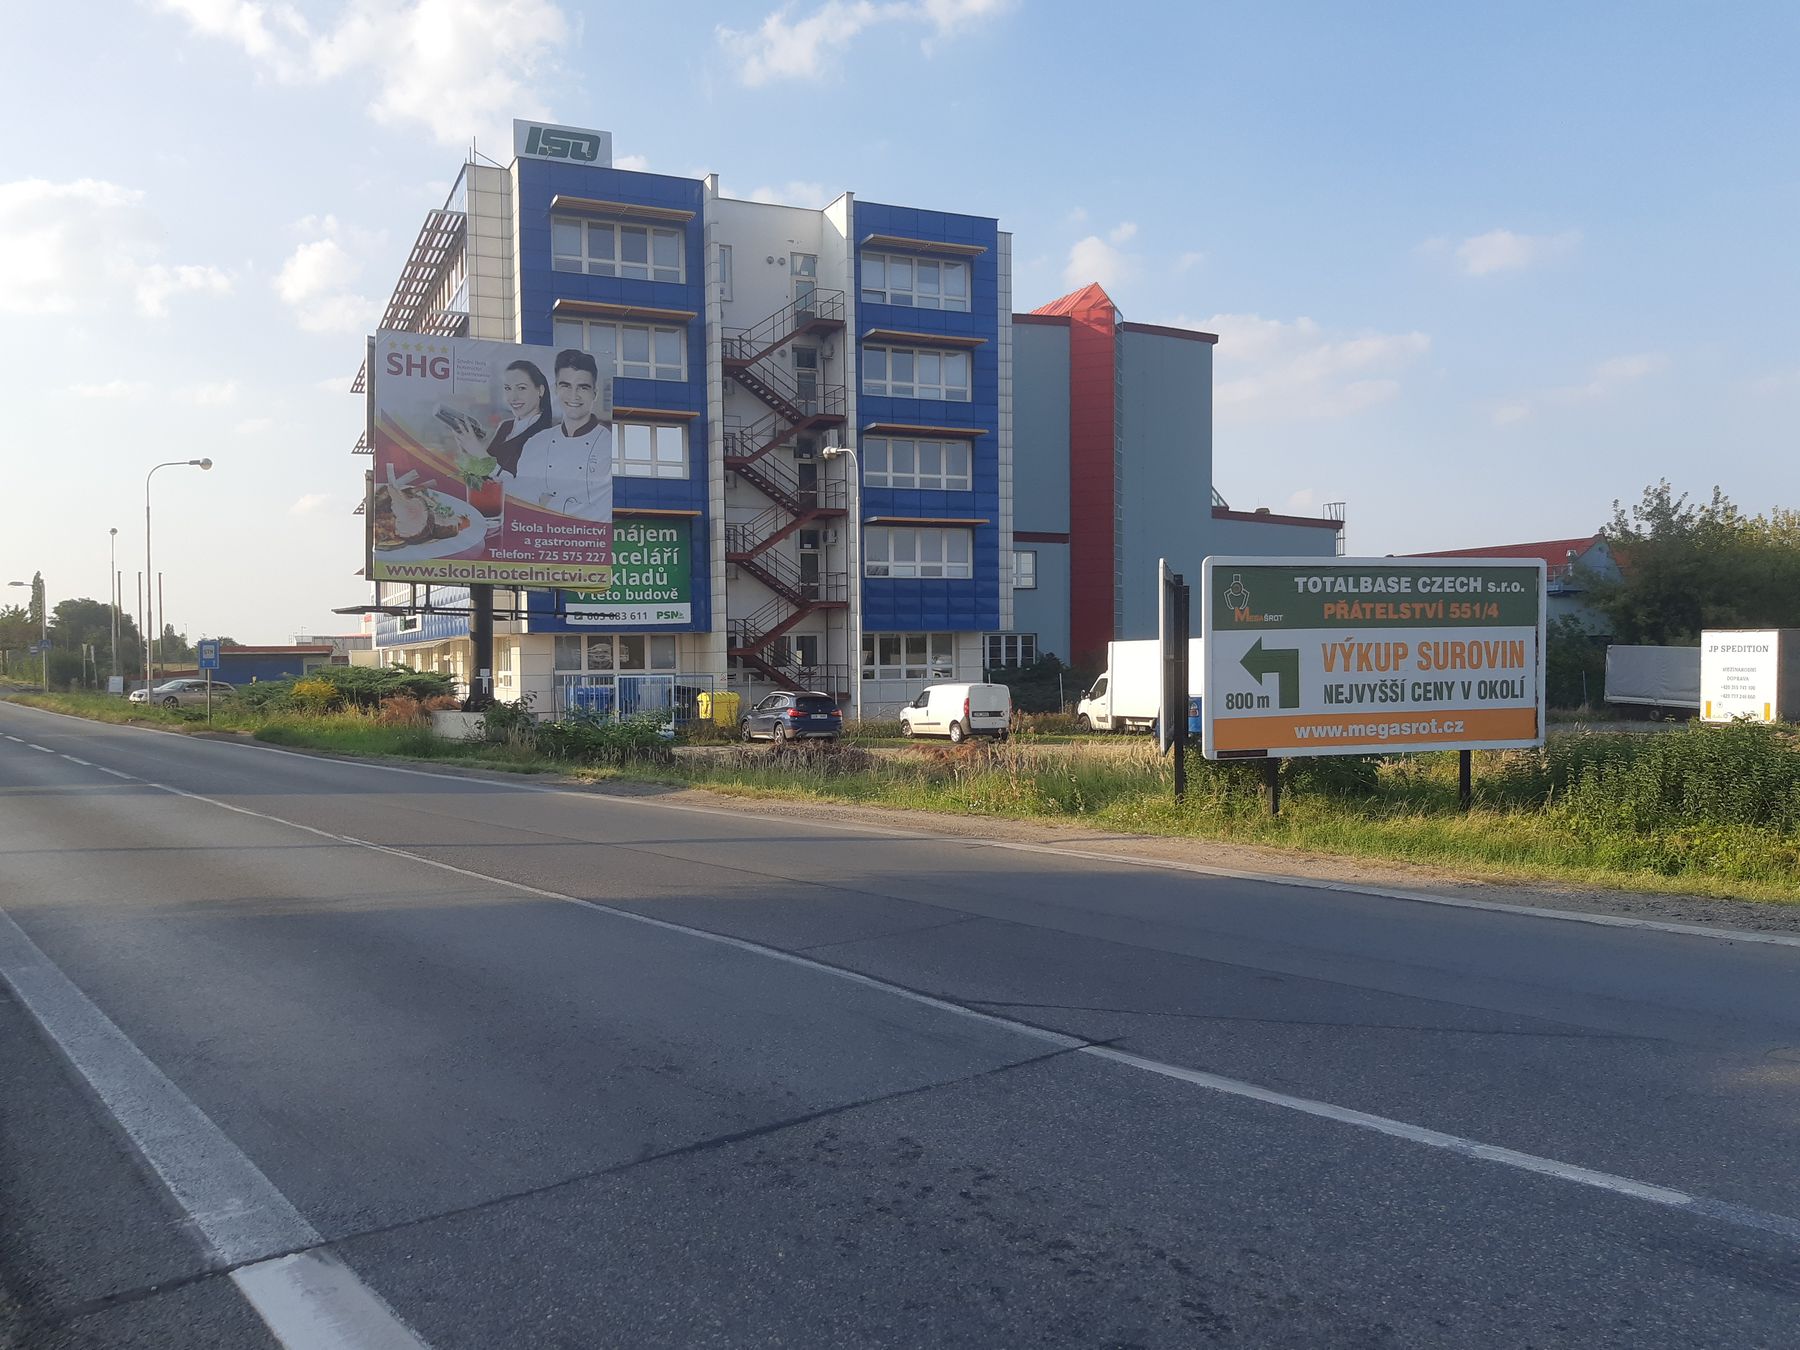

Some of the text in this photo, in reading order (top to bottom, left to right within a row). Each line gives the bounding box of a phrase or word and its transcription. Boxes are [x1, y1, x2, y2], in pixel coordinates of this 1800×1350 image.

[386, 352, 450, 380] SHG
[511, 520, 607, 536] Škola hotelnictví
[614, 524, 678, 546] nájem
[534, 537, 606, 548] gastronomie
[489, 549, 606, 562] Telefon: 725 575 227
[385, 563, 607, 583] www.skolahotelnictvi.cz
[610, 566, 668, 586] kladů
[1294, 576, 1525, 593] TOTALBASE CZECH s.r.o.
[626, 588, 678, 601] budově
[630, 611, 647, 620] 611
[1323, 599, 1500, 620] PŘÁTELSTVÍ 551/4
[1321, 637, 1525, 673] VÝKUP SUROVIN
[1708, 645, 1769, 653] JP SPEDITION
[1323, 676, 1525, 704] NEJVYŠŠÍ CENY V OKOLÍ
[1225, 692, 1270, 710] 800 m
[1294, 719, 1464, 740] www.megasrot.cz
